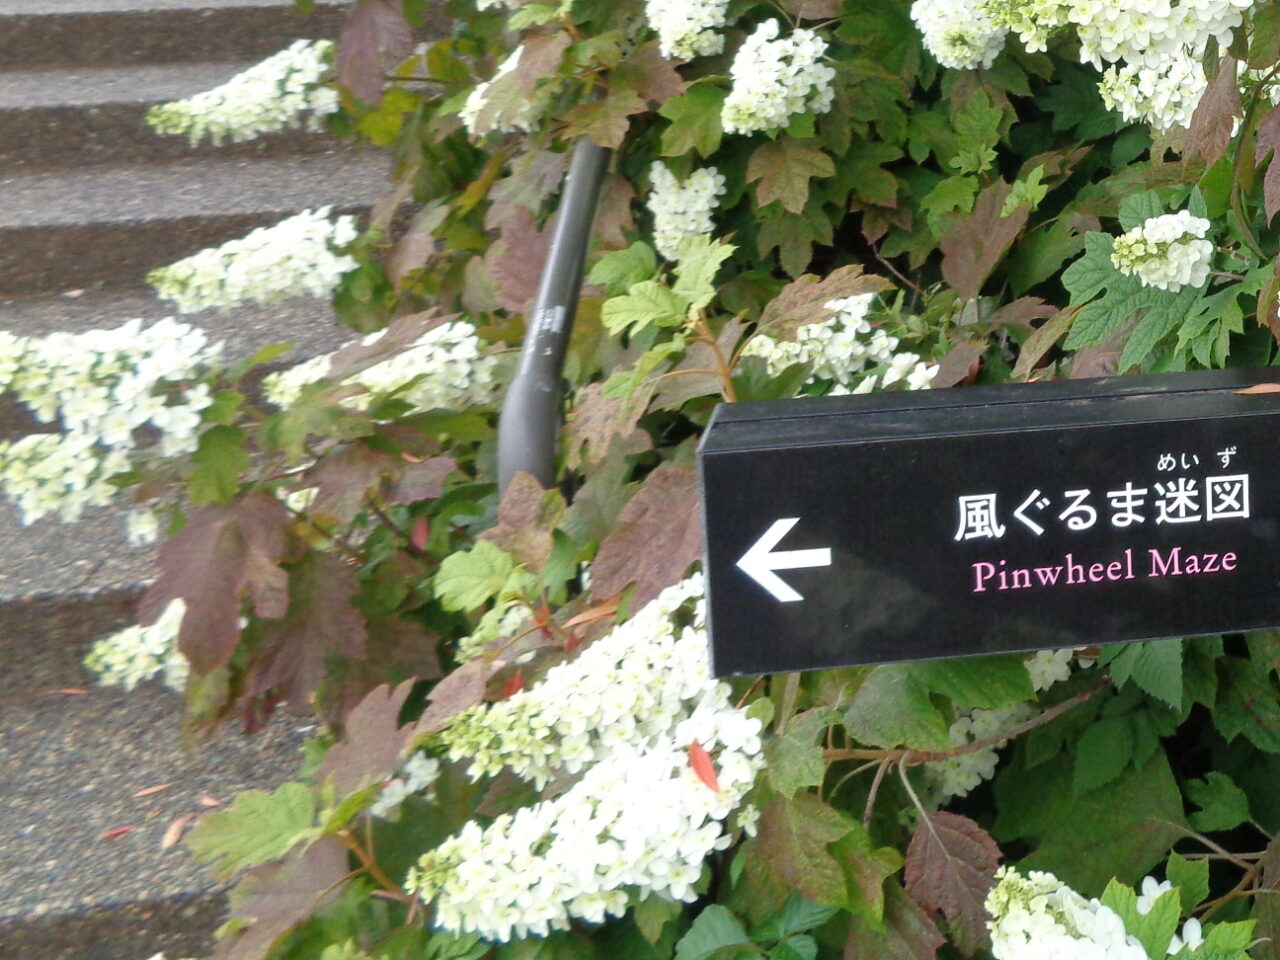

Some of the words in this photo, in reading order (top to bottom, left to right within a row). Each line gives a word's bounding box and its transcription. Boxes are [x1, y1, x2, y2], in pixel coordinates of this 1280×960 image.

[1157, 452, 1200, 472] めい
[954, 473, 1250, 541] 風ぐるま迷図
[972, 549, 1136, 593] Pinwheel
[1148, 547, 1238, 578] Maze
